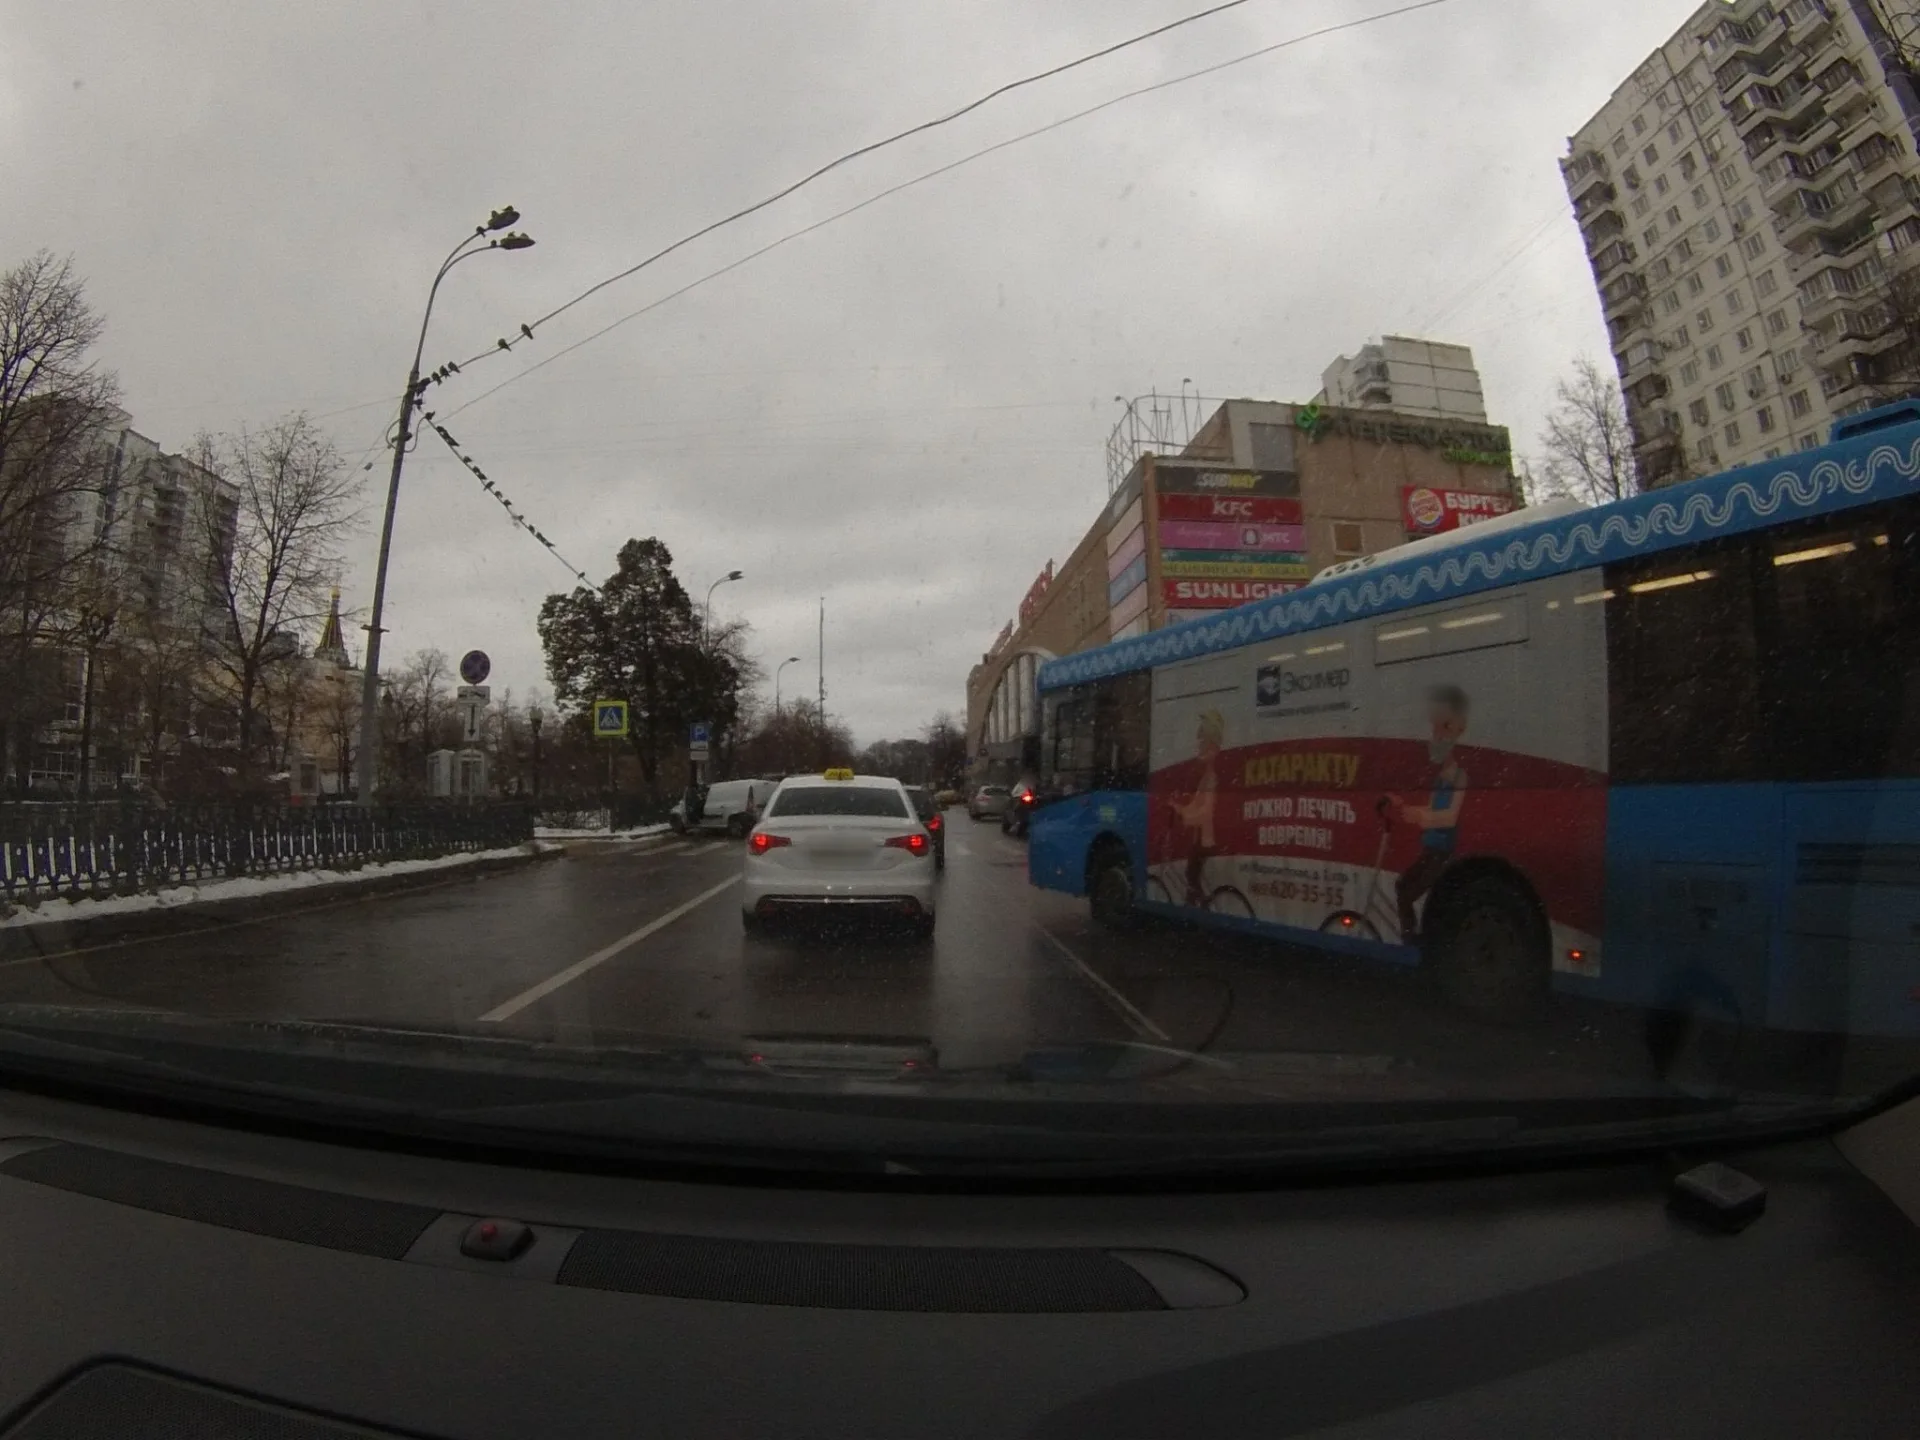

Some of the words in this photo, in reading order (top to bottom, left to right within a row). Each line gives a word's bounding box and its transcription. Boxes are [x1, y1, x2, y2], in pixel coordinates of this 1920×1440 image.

[1196, 472, 1262, 489] SUBWAY
[1212, 501, 1253, 517] KFC
[1176, 581, 1298, 599] SUNLIGHT
[1244, 753, 1359, 788] КАТАРАКТУ
[1243, 797, 1293, 820] НУЖНО
[1296, 798, 1357, 824] ЛЕЧИТЬ
[1258, 825, 1333, 851] ВОВРЕМЯ!
[1271, 881, 1346, 906] 620-35-55
